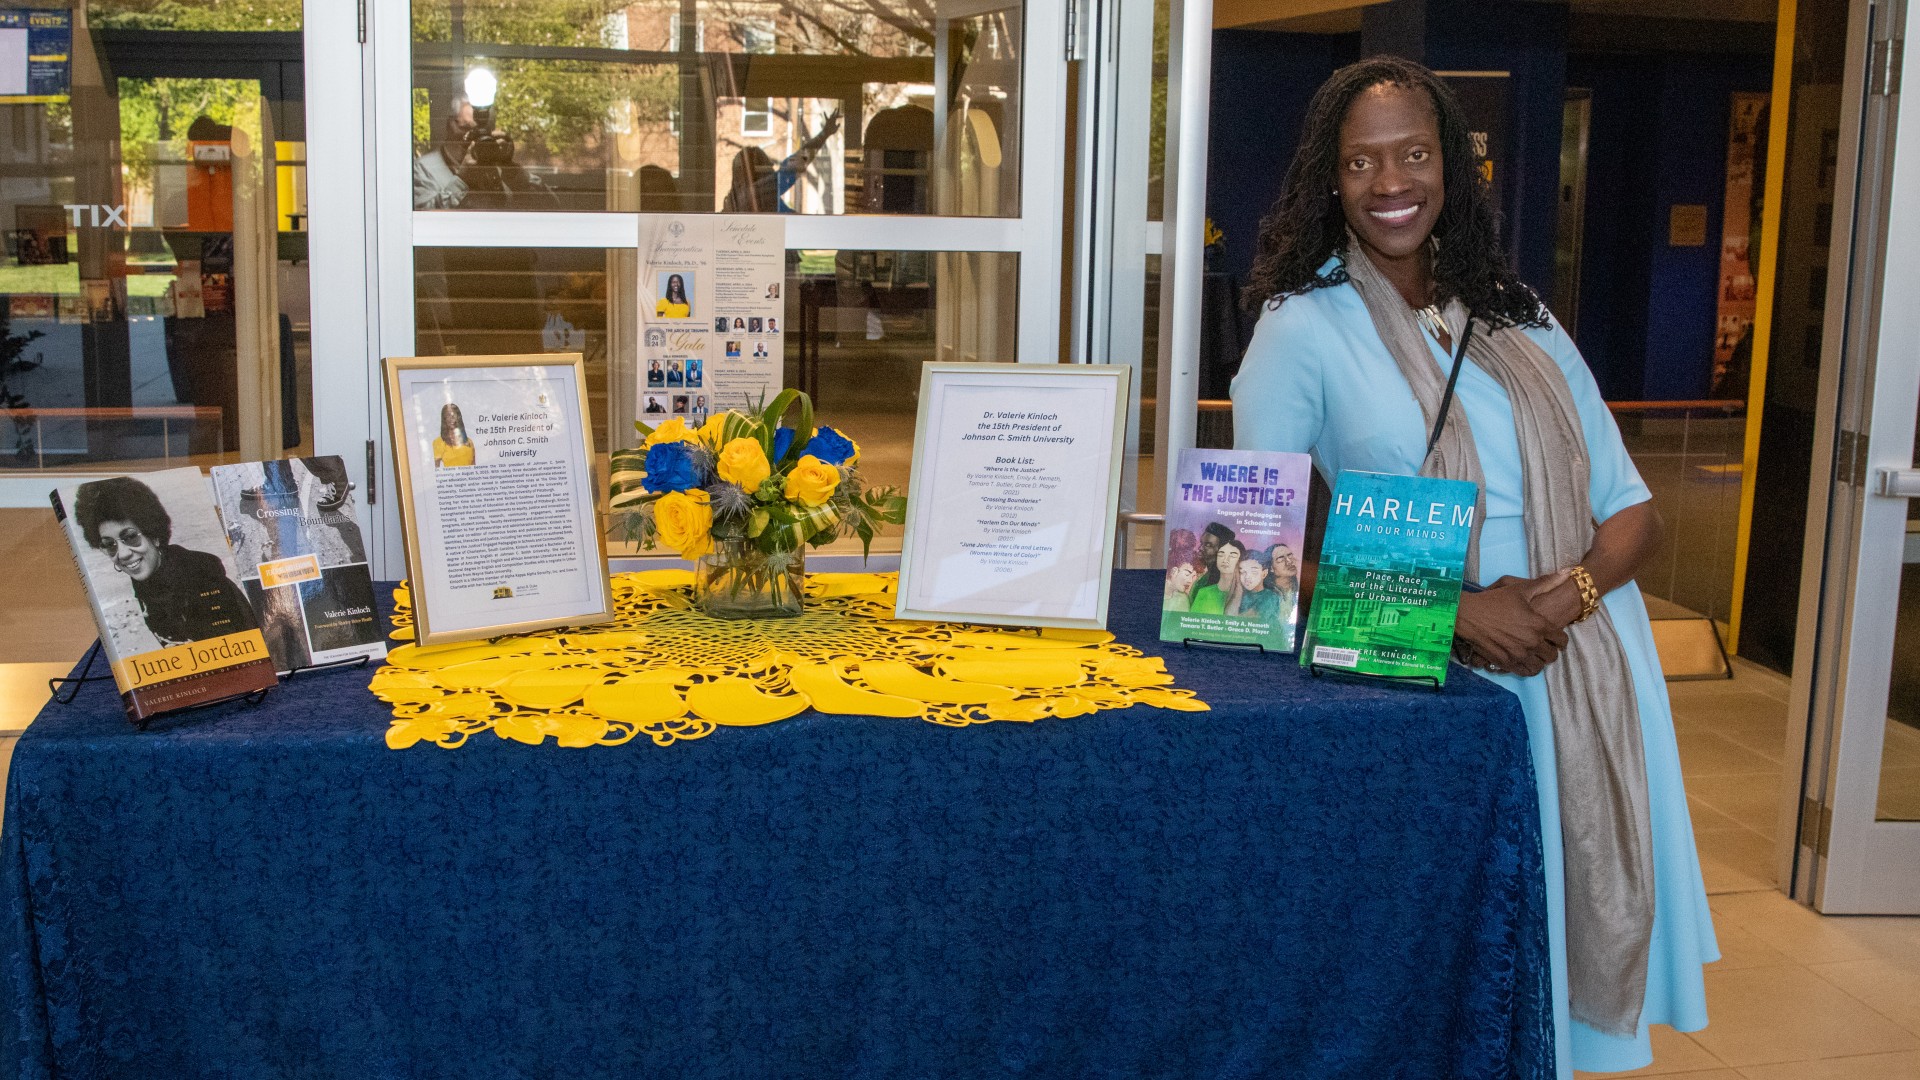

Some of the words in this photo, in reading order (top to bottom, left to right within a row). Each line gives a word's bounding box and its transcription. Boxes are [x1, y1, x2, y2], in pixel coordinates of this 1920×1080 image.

[64, 204, 126, 228] TIX
[738, 233, 766, 246] Events
[670, 332, 705, 351] Gala
[509, 425, 544, 433] President
[1033, 435, 1074, 445] University
[499, 449, 537, 458] University
[1200, 462, 1258, 483] WHERE
[1264, 467, 1278, 485] IS
[1182, 484, 1213, 503] THE
[1217, 486, 1294, 506] JUSTICE?
[256, 506, 299, 518] Crossing
[1217, 510, 1244, 518] Engaged
[1246, 511, 1281, 520] Pedagogies
[1336, 494, 1474, 528] HARLEM
[300, 514, 350, 526] Boundaries
[1357, 524, 1371, 532] ON
[1378, 526, 1400, 536] OUR
[1407, 529, 1445, 540] MINDS
[72, 554, 89, 595] Jordan
[1366, 572, 1395, 582] Place,
[1399, 575, 1424, 586] Race,
[1370, 583, 1384, 591] the
[1389, 584, 1437, 596] Literacies
[1369, 593, 1396, 602] Urban
[1402, 596, 1428, 606] Youth
[324, 610, 346, 618] Valerie
[348, 606, 371, 615] Kinloch
[131, 656, 182, 685] June
[188, 638, 257, 671] Jordan
[1382, 651, 1418, 661] KINLOCH
[144, 695, 174, 707] VALERIE
[176, 687, 207, 698] KINLOCH
